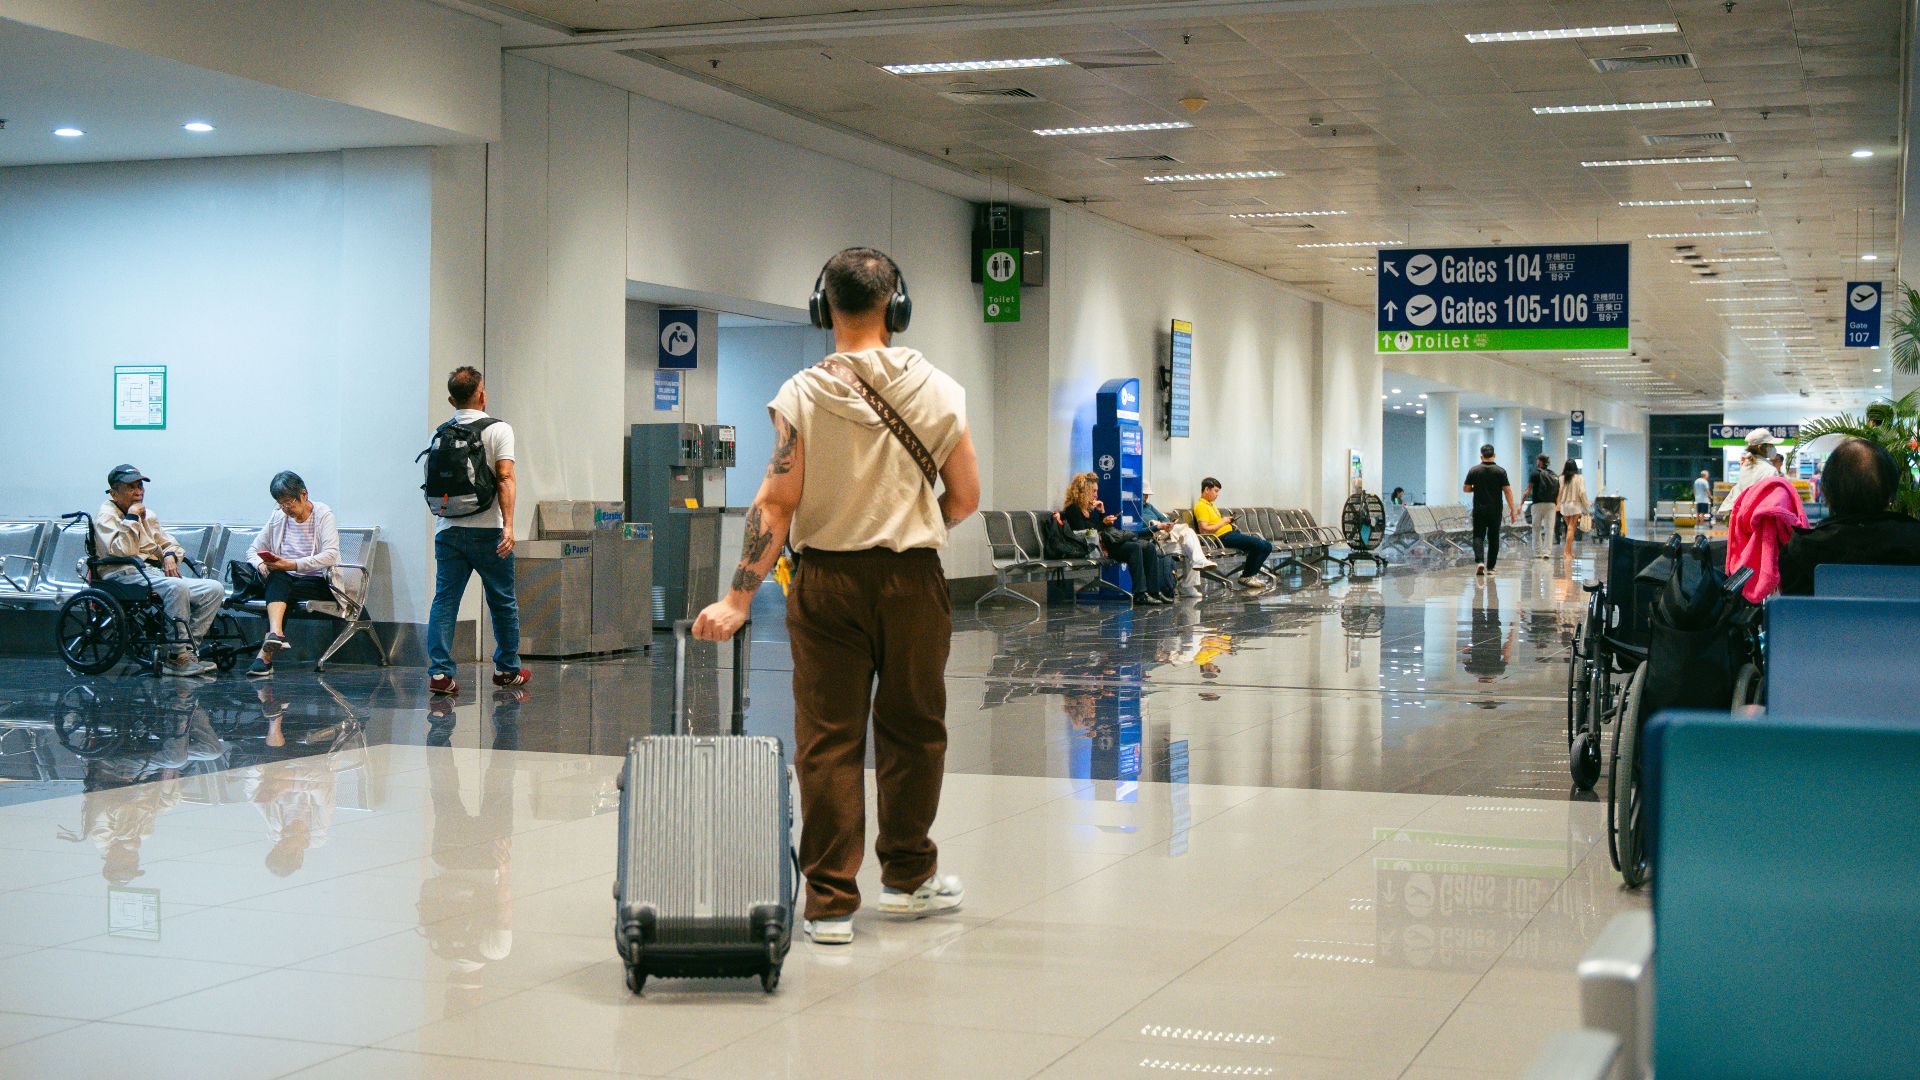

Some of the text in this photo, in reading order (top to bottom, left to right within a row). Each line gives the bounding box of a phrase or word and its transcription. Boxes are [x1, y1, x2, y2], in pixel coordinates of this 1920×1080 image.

[1441, 254, 1542, 283] Gates 104
[988, 295, 1015, 303] Toilet
[1441, 293, 1588, 323] Gates 105-106
[1850, 321, 1868, 329] Gate
[1415, 333, 1469, 348] Toilet
[1849, 332, 1870, 342] 107
[602, 511, 623, 520] Plastic
[572, 545, 590, 554] Paper
